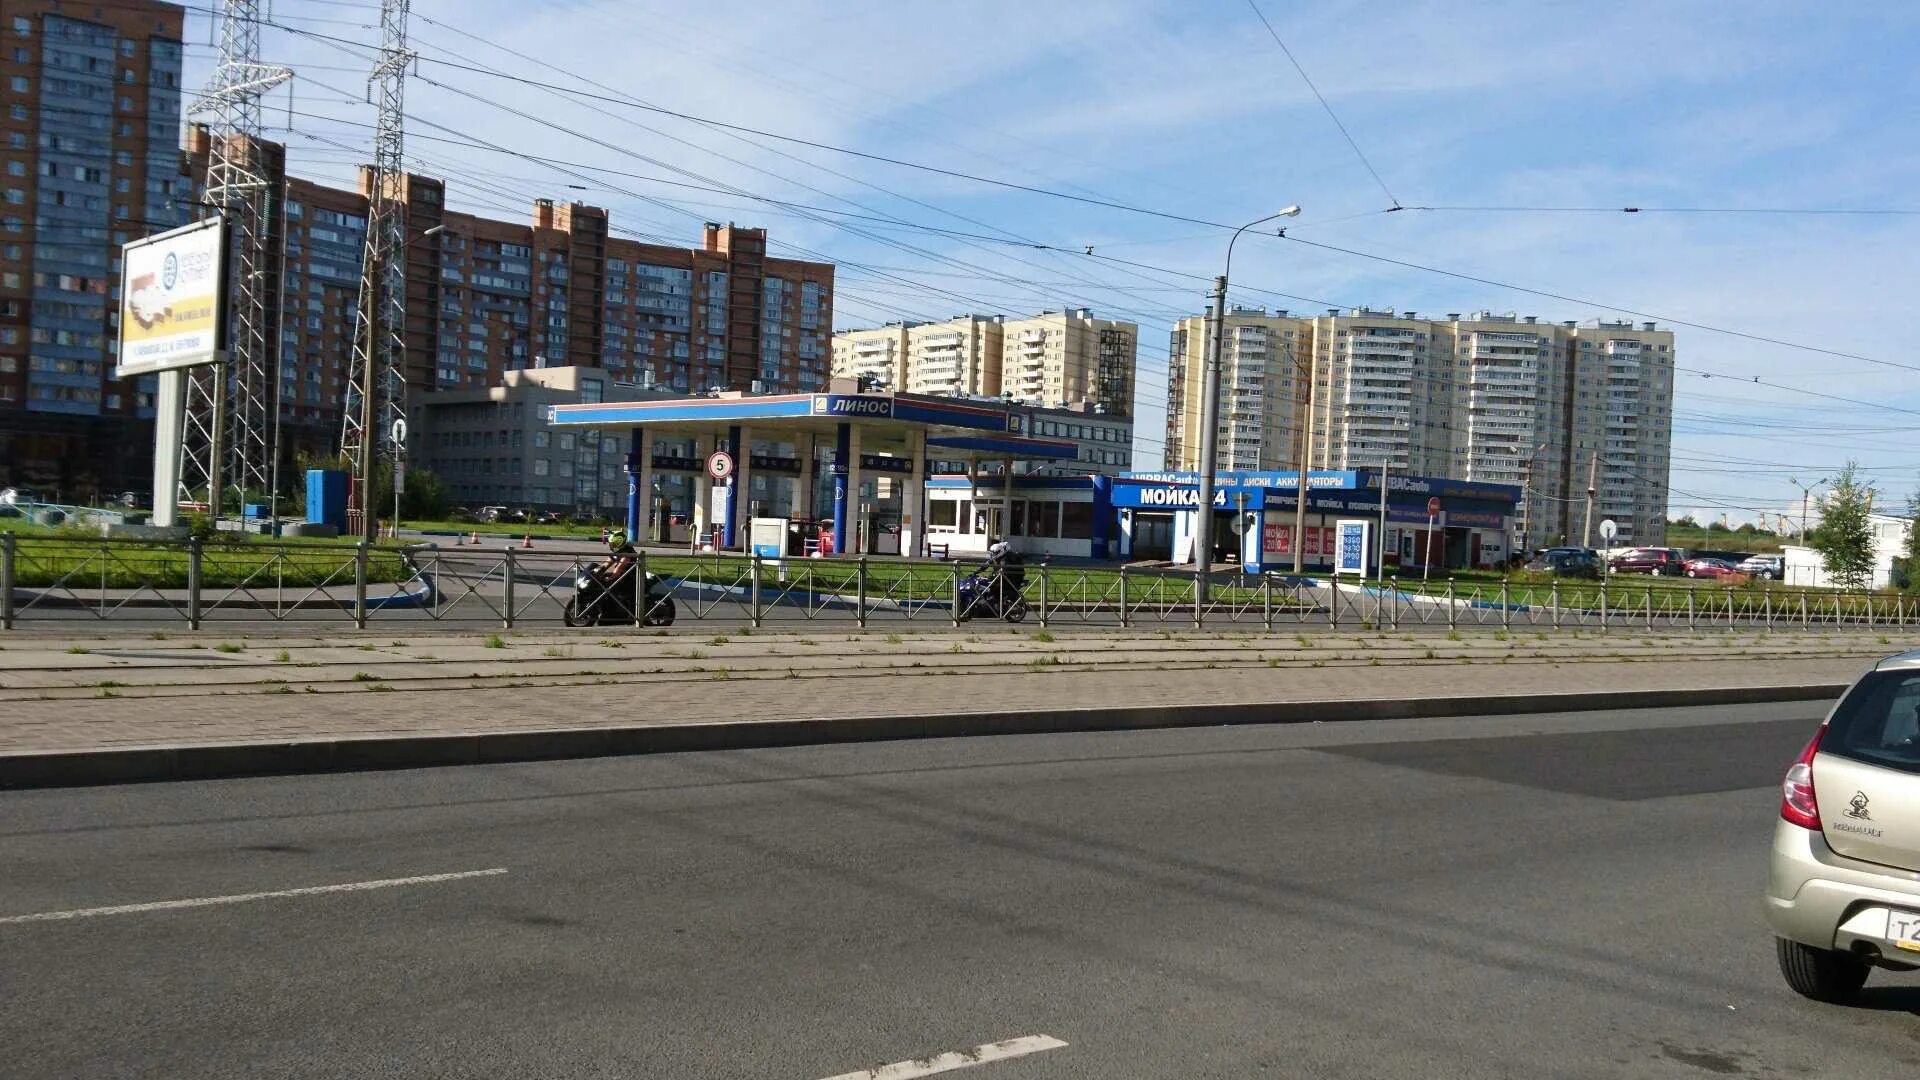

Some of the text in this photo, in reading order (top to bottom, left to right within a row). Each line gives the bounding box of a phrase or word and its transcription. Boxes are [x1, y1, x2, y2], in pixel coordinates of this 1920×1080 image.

[832, 399, 889, 414] ЛИНОС
[716, 459, 724, 471] 5
[1243, 477, 1271, 487] ДИСКИ
[1276, 477, 1343, 487] АККУЛЯТОРЫ
[1140, 486, 1201, 505] МОЙКА
[1265, 495, 1312, 506] ХИМЧИСА
[1348, 501, 1390, 512] ПОЛИРОА
